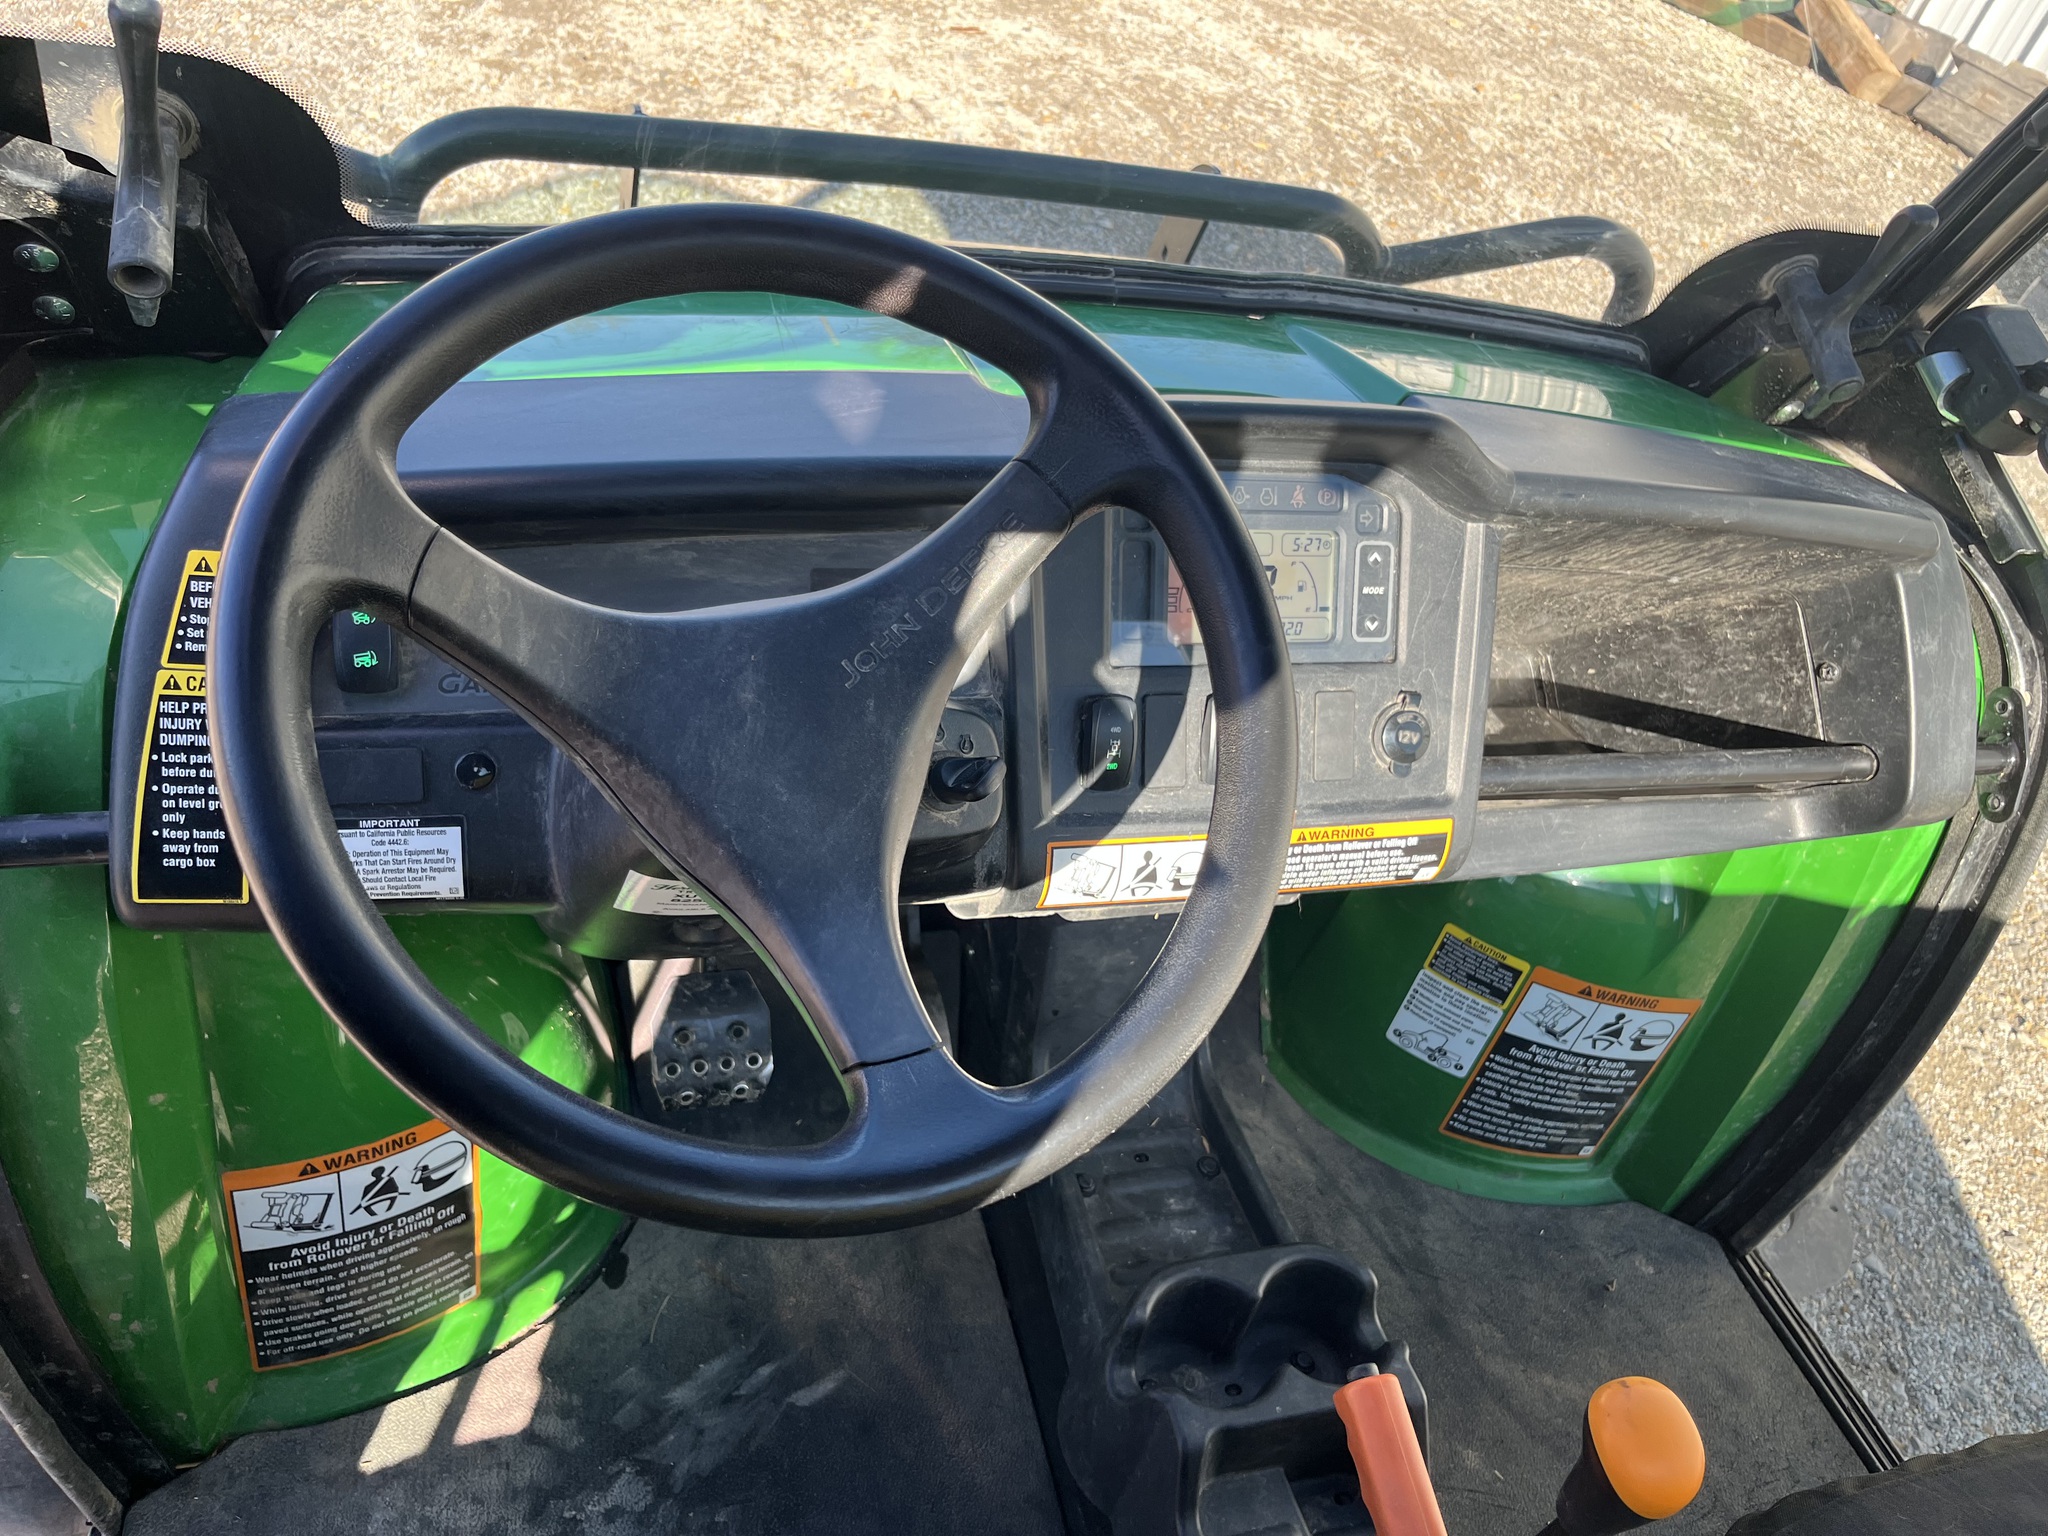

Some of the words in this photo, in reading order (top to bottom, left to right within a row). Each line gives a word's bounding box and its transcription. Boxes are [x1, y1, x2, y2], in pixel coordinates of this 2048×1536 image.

[1292, 537, 1322, 552] 5:27
[190, 580, 215, 593] BEF
[1362, 586, 1385, 595] MODE
[841, 612, 922, 689] JOHN
[915, 512, 1024, 617] DEERE
[186, 627, 204, 638] Set
[438, 673, 488, 694] GA
[159, 701, 190, 714] HELP
[159, 717, 202, 731] INJURY
[1398, 729, 1420, 745] 12V
[161, 751, 187, 763] Lock
[161, 766, 197, 777] before
[200, 767, 216, 778] du
[161, 783, 205, 796] Operate
[162, 799, 176, 808] on
[178, 798, 205, 809] level
[162, 812, 186, 824] only
[359, 818, 421, 829] IMPORTANT
[162, 828, 190, 841] Keep
[193, 828, 226, 840] hands
[366, 829, 395, 837] California
[396, 829, 415, 837] Public
[416, 828, 447, 836] Resources
[1309, 827, 1375, 841] WARNING
[162, 844, 191, 855] away
[194, 843, 219, 853] from
[371, 839, 386, 847] Code
[352, 850, 382, 859] Operation
[390, 849, 402, 857] This
[404, 848, 435, 857] Equipment
[436, 848, 449, 856] May
[162, 857, 193, 869] cargo
[196, 856, 216, 867] box
[364, 859, 378, 867] That
[392, 858, 407, 866] Start
[408, 857, 422, 865] Fires
[446, 856, 456, 865] Dry
[362, 868, 380, 876] Spark
[381, 867, 405, 875] Arrestor
[406, 867, 419, 875] May
[361, 876, 383, 884] Should
[387, 883, 421, 891] Regulations
[1473, 941, 1507, 961] CAUTION
[1596, 989, 1660, 1009] WARNING
[1509, 1047, 1533, 1059] from
[1534, 1055, 1574, 1070] Rollover
[1587, 1067, 1618, 1076] Falling
[1529, 1044, 1556, 1056] Avoid
[1557, 1052, 1586, 1064] Injury
[1599, 1060, 1626, 1068] Death
[323, 1132, 417, 1170] WARNING
[268, 1257, 302, 1270] from
[306, 1241, 366, 1262] Rollover
[371, 1235, 384, 1246] or
[389, 1217, 433, 1240] Falling
[437, 1205, 455, 1220] Off
[290, 1241, 330, 1256] Avoid
[335, 1228, 375, 1248] Injury
[379, 1223, 393, 1233] or
[397, 1206, 434, 1227] Death
[255, 1274, 279, 1282] Wear
[281, 1267, 317, 1279] helmets
[320, 1261, 343, 1271] when
[345, 1250, 375, 1265] driving
[433, 1225, 442, 1233] on
[444, 1212, 466, 1228] rough
[338, 1270, 347, 1278] or
[350, 1266, 358, 1274] at
[360, 1258, 387, 1272] higher
[327, 1282, 345, 1292] legs
[358, 1269, 384, 1283] during
[261, 1306, 286, 1315] While
[325, 1293, 347, 1302] drive
[349, 1286, 368, 1295] slow
[371, 1280, 386, 1289] and
[400, 1270, 413, 1278] not
[262, 1317, 283, 1325] Drive
[285, 1311, 311, 1322] slowly
[313, 1306, 334, 1316] when
[283, 1332, 312, 1342] brakes
[314, 1327, 337, 1337] going
[339, 1320, 361, 1329] down
